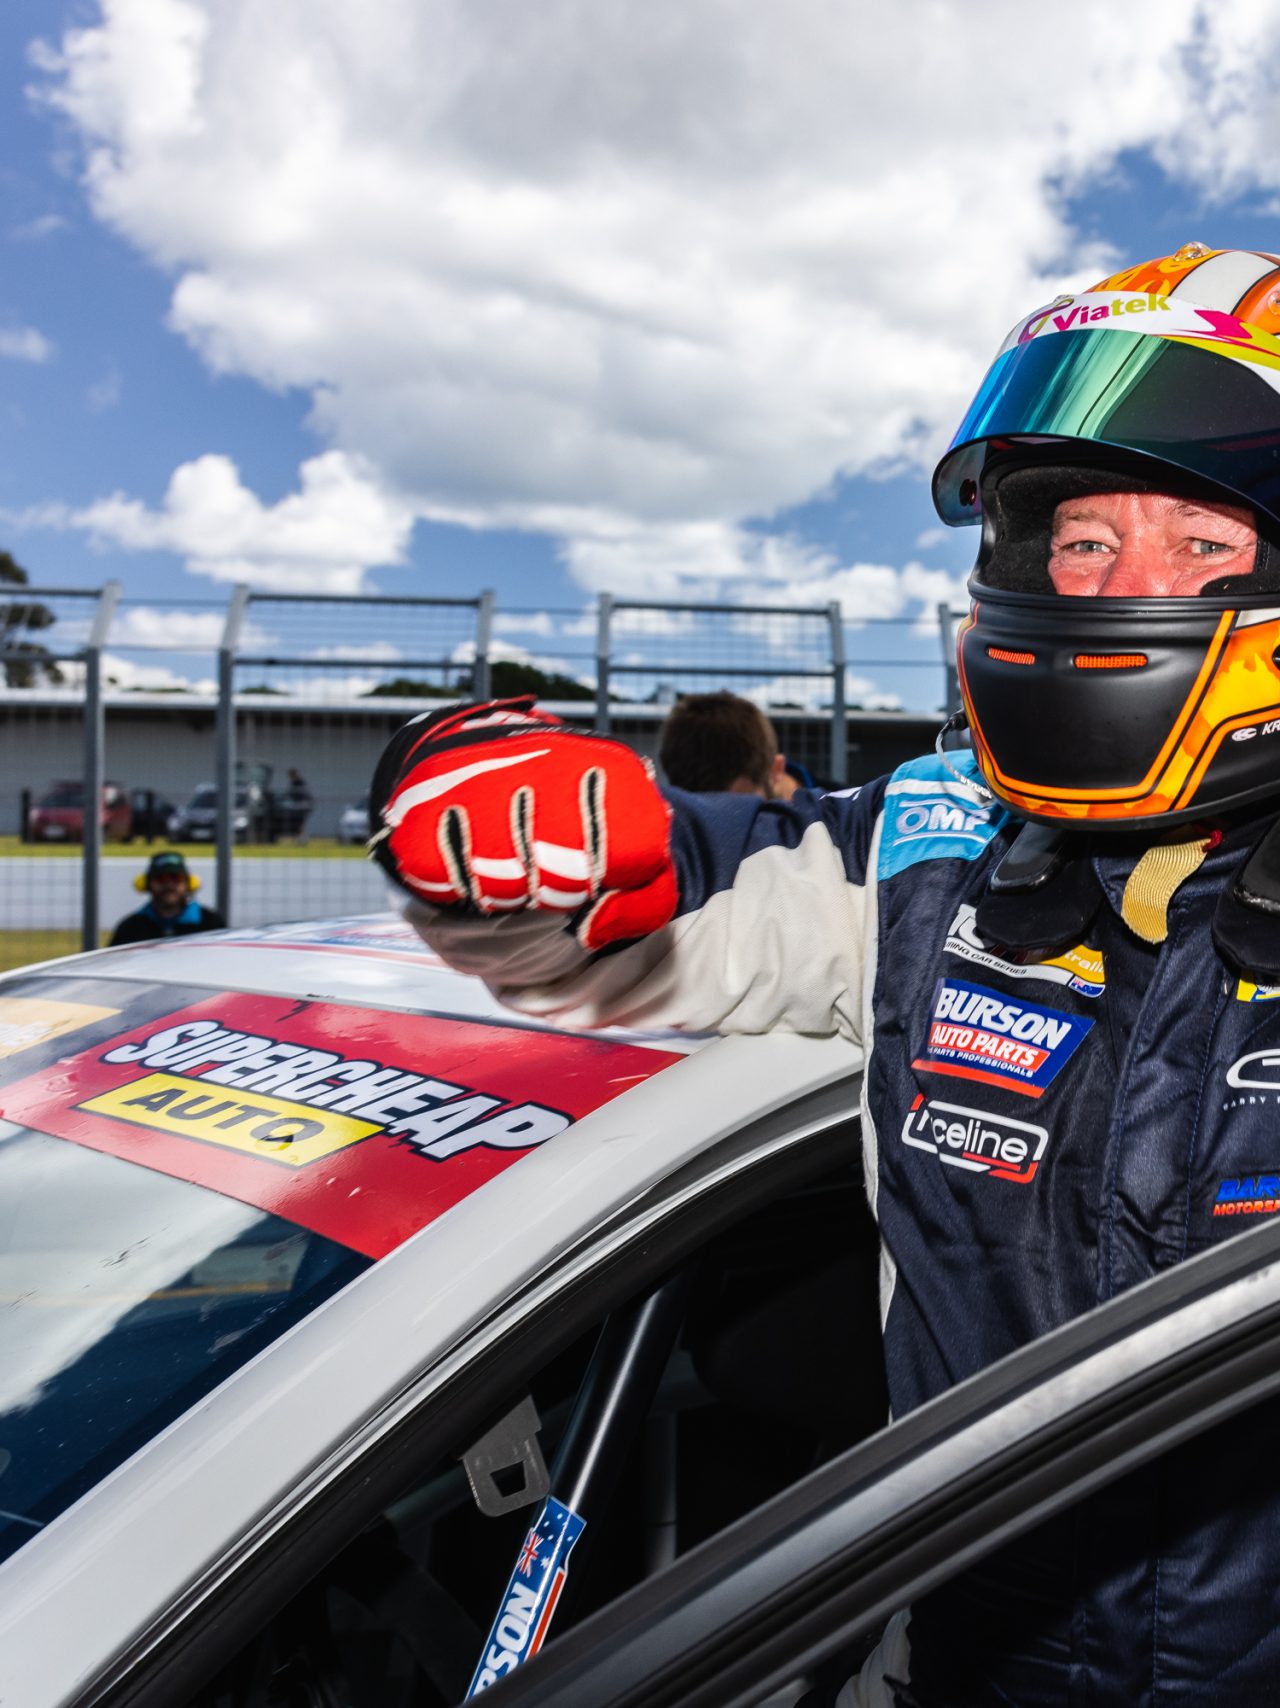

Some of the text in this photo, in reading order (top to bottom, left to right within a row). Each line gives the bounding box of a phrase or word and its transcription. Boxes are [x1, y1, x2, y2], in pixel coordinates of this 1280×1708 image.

[1053, 294, 1171, 331] Viatek
[896, 803, 990, 835] OMP
[935, 987, 1072, 1050] BURSON
[931, 1025, 1039, 1067] AUTO PARTS
[956, 1051, 1034, 1079] PROFESSIONALS
[101, 1019, 574, 1161] SUPERCHEAP
[123, 1086, 324, 1151] AUTO
